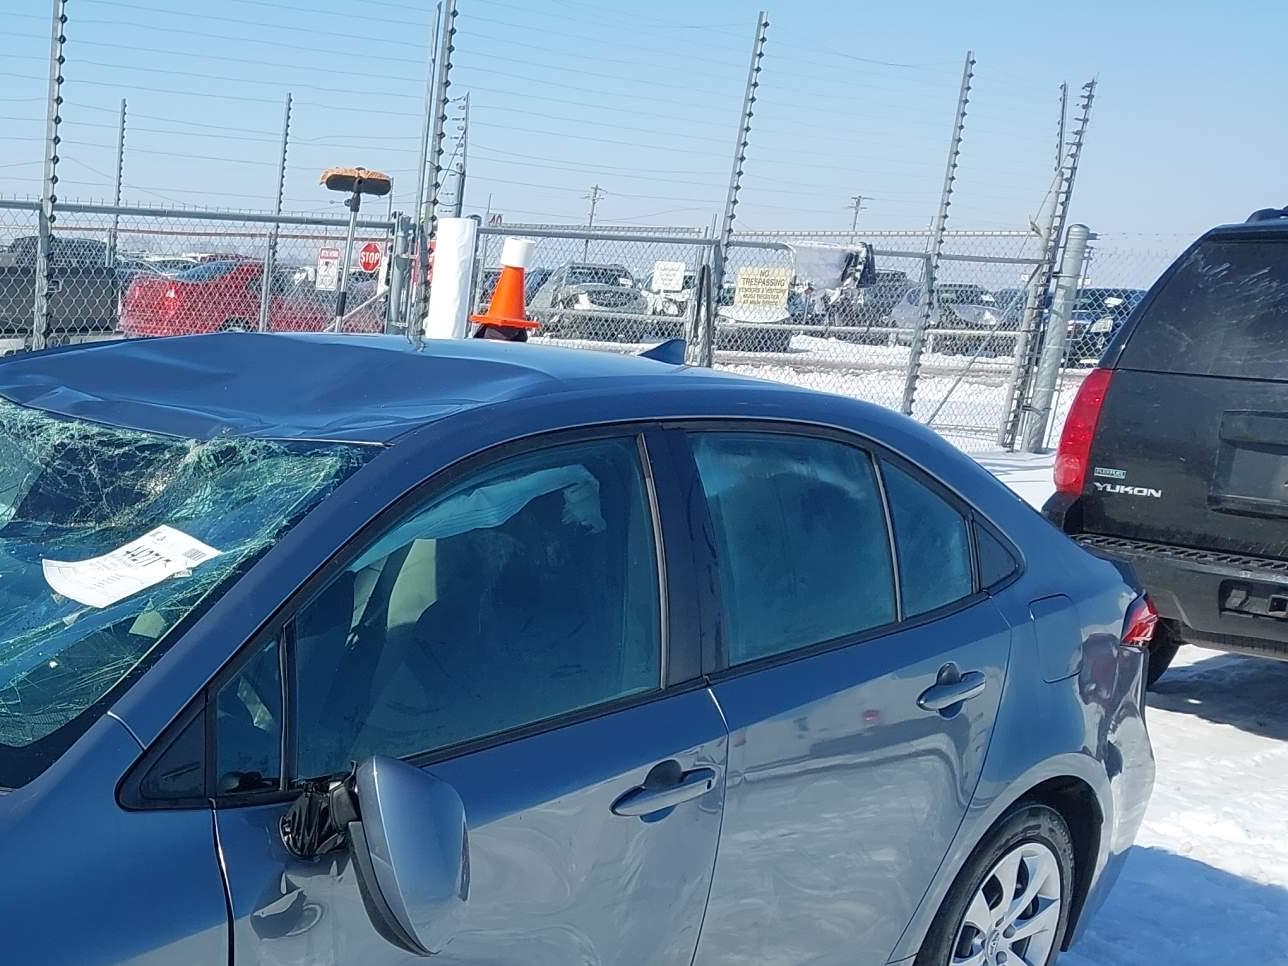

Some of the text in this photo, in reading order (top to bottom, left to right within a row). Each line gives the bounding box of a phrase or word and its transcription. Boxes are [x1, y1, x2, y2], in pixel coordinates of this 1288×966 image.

[361, 252, 380, 264] STOP
[760, 270, 770, 278] NO
[741, 278, 785, 287] TRESPASSING
[1093, 481, 1162, 498] YUKON
